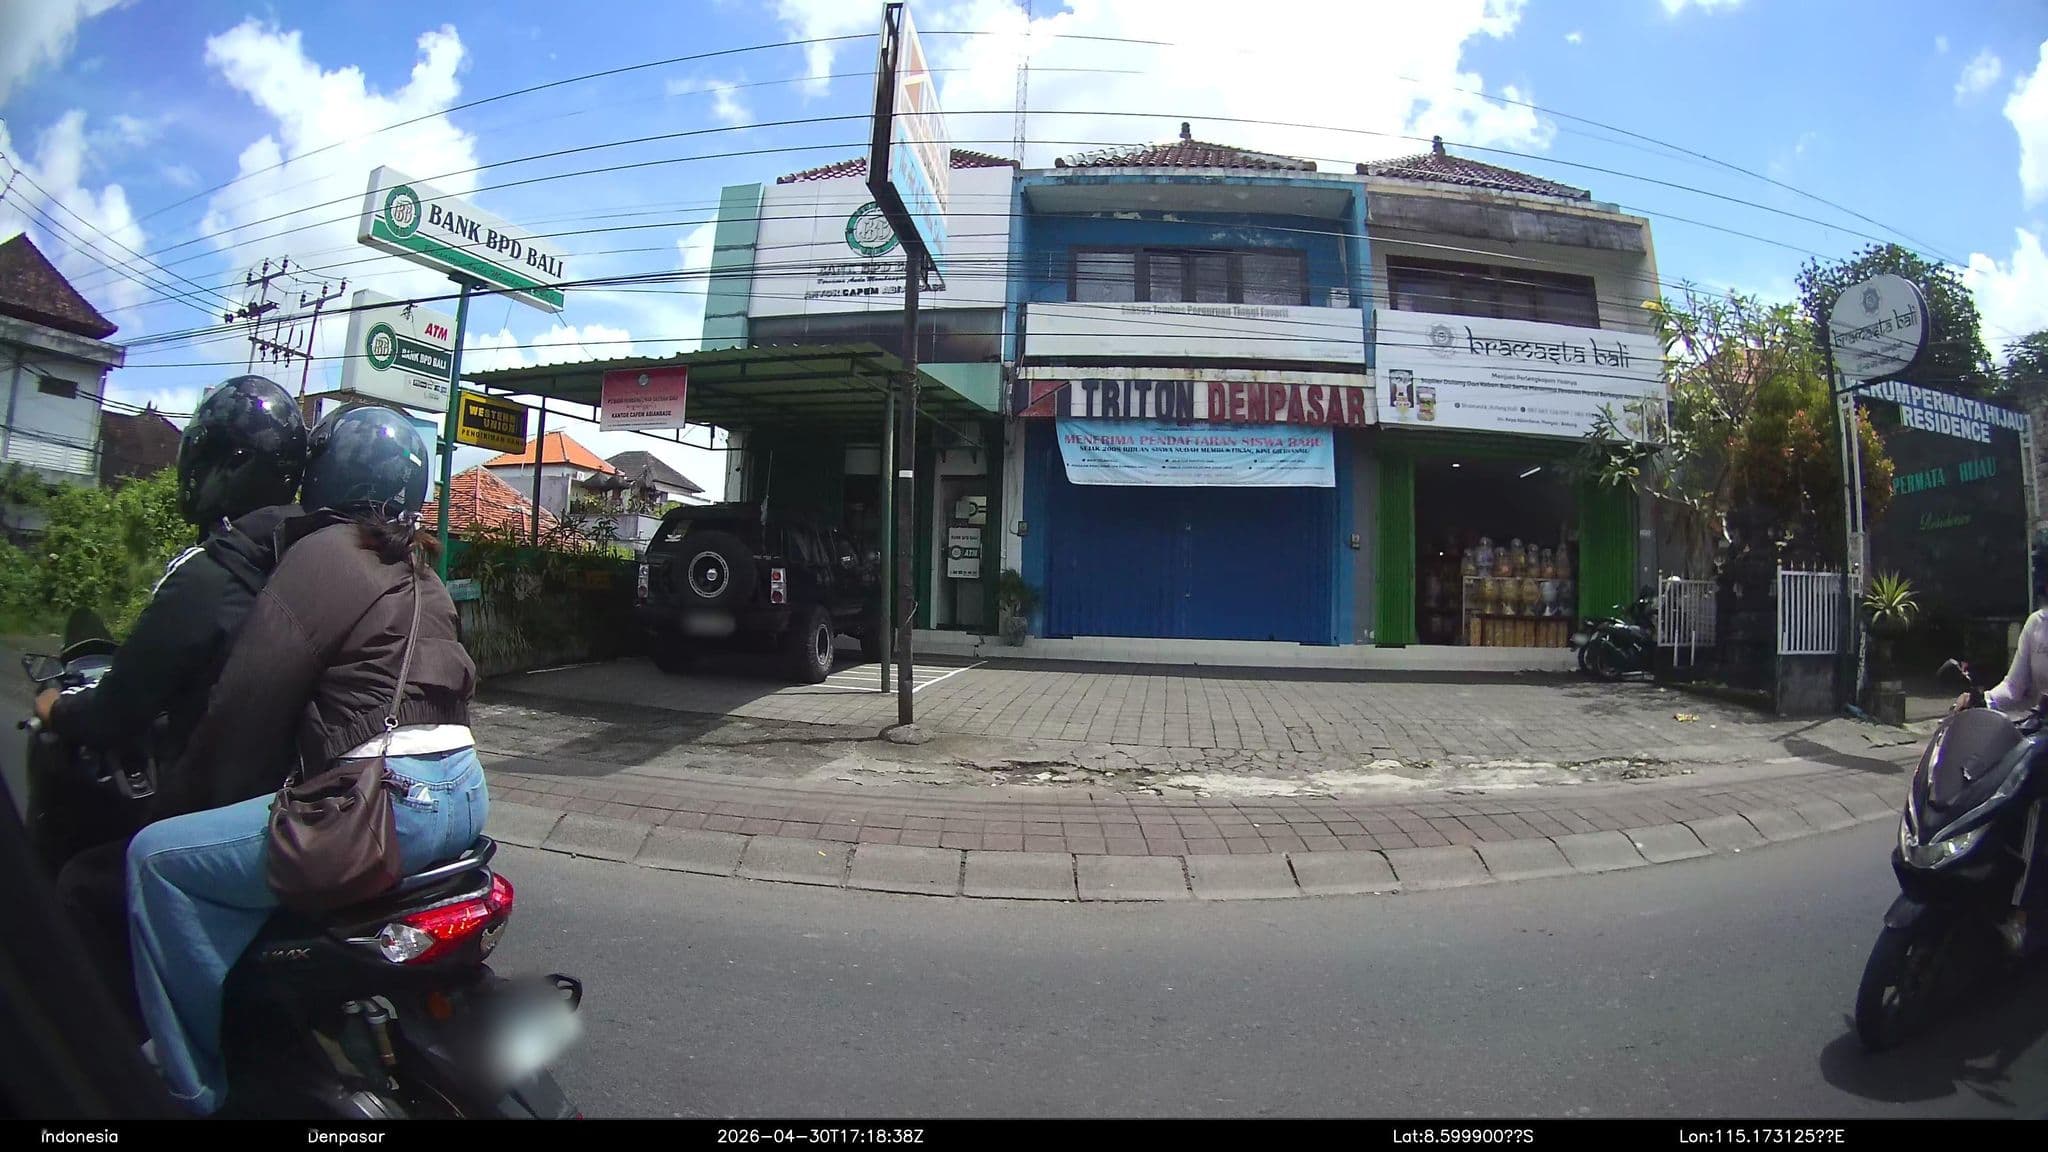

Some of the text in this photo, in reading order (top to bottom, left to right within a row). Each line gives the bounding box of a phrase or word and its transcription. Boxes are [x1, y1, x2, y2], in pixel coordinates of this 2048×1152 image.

[428, 203, 482, 243] BANK
[485, 228, 522, 260] BPD
[526, 246, 564, 279] BALI
[842, 287, 879, 297] CAPEM
[1892, 303, 1919, 330] bali
[424, 322, 449, 344] ATM
[1464, 325, 1631, 368] bramasta bali
[401, 348, 447, 370] BANK BPD BALI
[469, 404, 516, 423] WESTERN
[1080, 379, 1366, 427] TRITON DENPASAR
[1910, 385, 1985, 422] PERMATA
[1984, 403, 2025, 432] HIJAU
[483, 417, 516, 433] UNION
[611, 411, 629, 419] KANTOR
[1901, 404, 1992, 444] RESIDENCE
[461, 428, 505, 443] PENGIRIMAN
[1064, 433, 1323, 449] MENERIMA PENDAFTARAN SISWA BARU
[1892, 456, 1997, 496] PERMATA HIJAU
[964, 549, 977, 557] ATM
